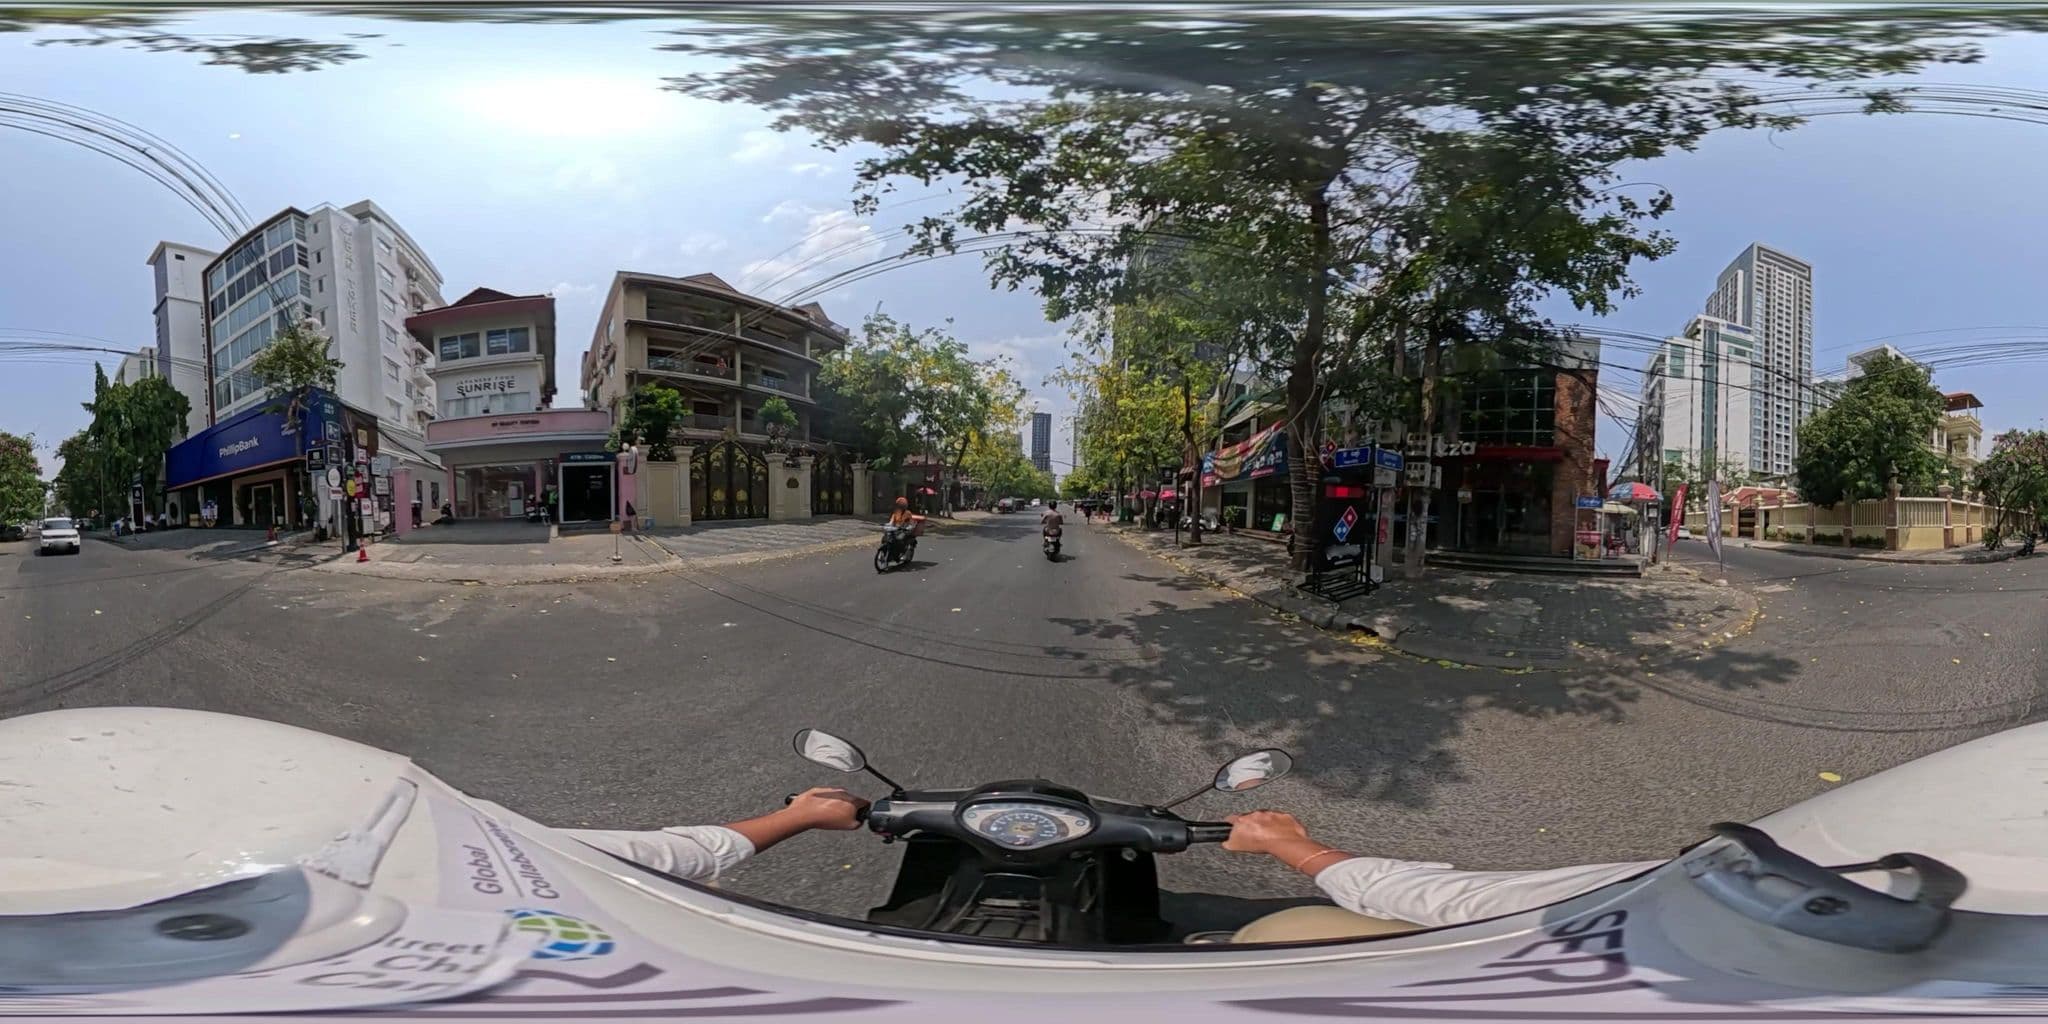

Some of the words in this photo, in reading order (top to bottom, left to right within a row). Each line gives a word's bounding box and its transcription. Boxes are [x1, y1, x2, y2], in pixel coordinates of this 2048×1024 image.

[456, 380, 516, 395] SUNRISE
[218, 436, 259, 458] PhillipBank
[462, 843, 504, 895] Global
